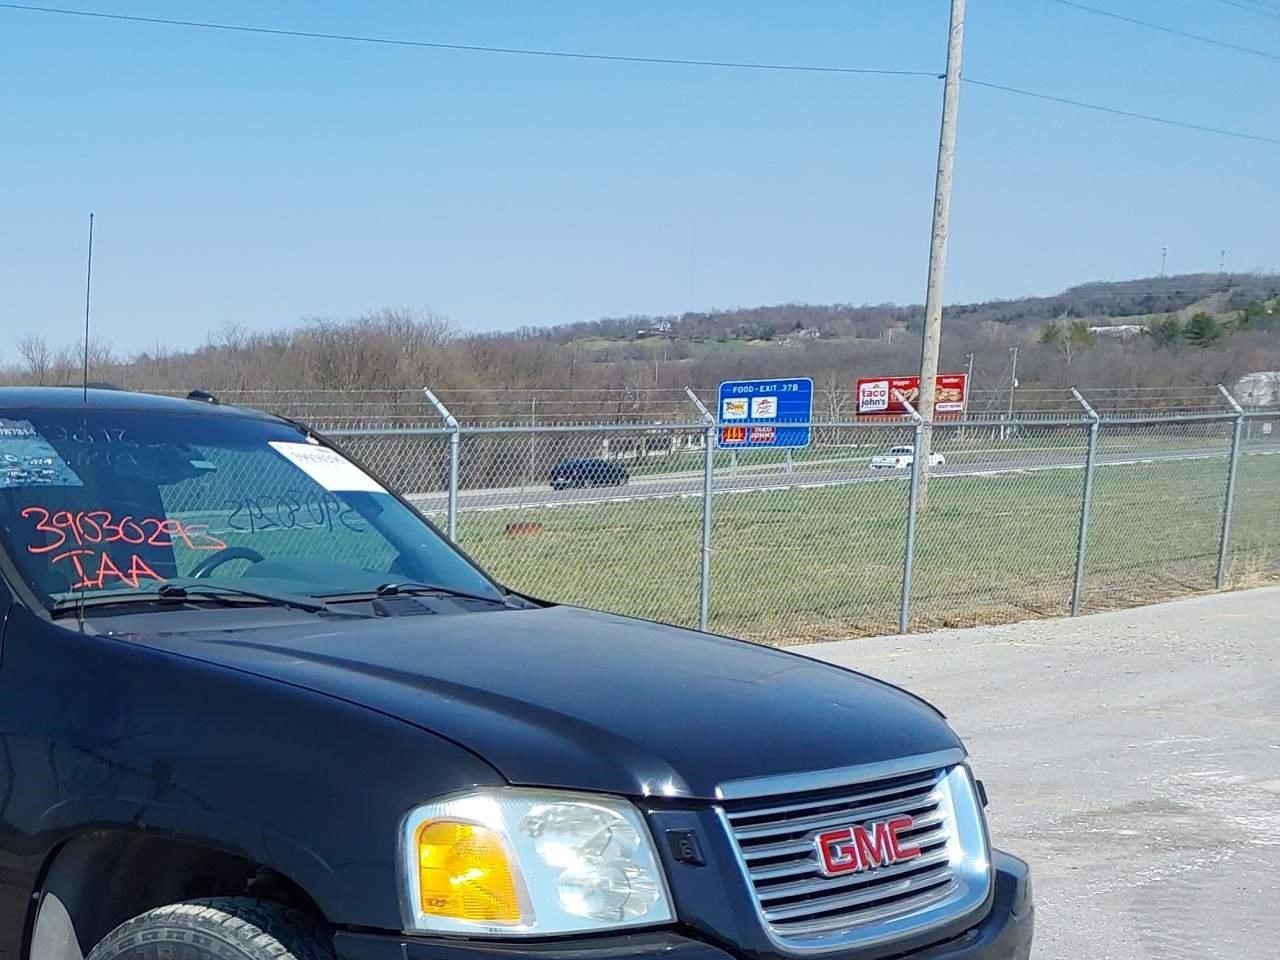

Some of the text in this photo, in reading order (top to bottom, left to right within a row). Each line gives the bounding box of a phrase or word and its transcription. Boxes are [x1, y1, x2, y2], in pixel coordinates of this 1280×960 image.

[861, 389, 886, 398] taco
[861, 398, 886, 407] john's
[22, 507, 228, 553] 39030295
[52, 550, 168, 589] IAA
[818, 815, 921, 876] GMC
